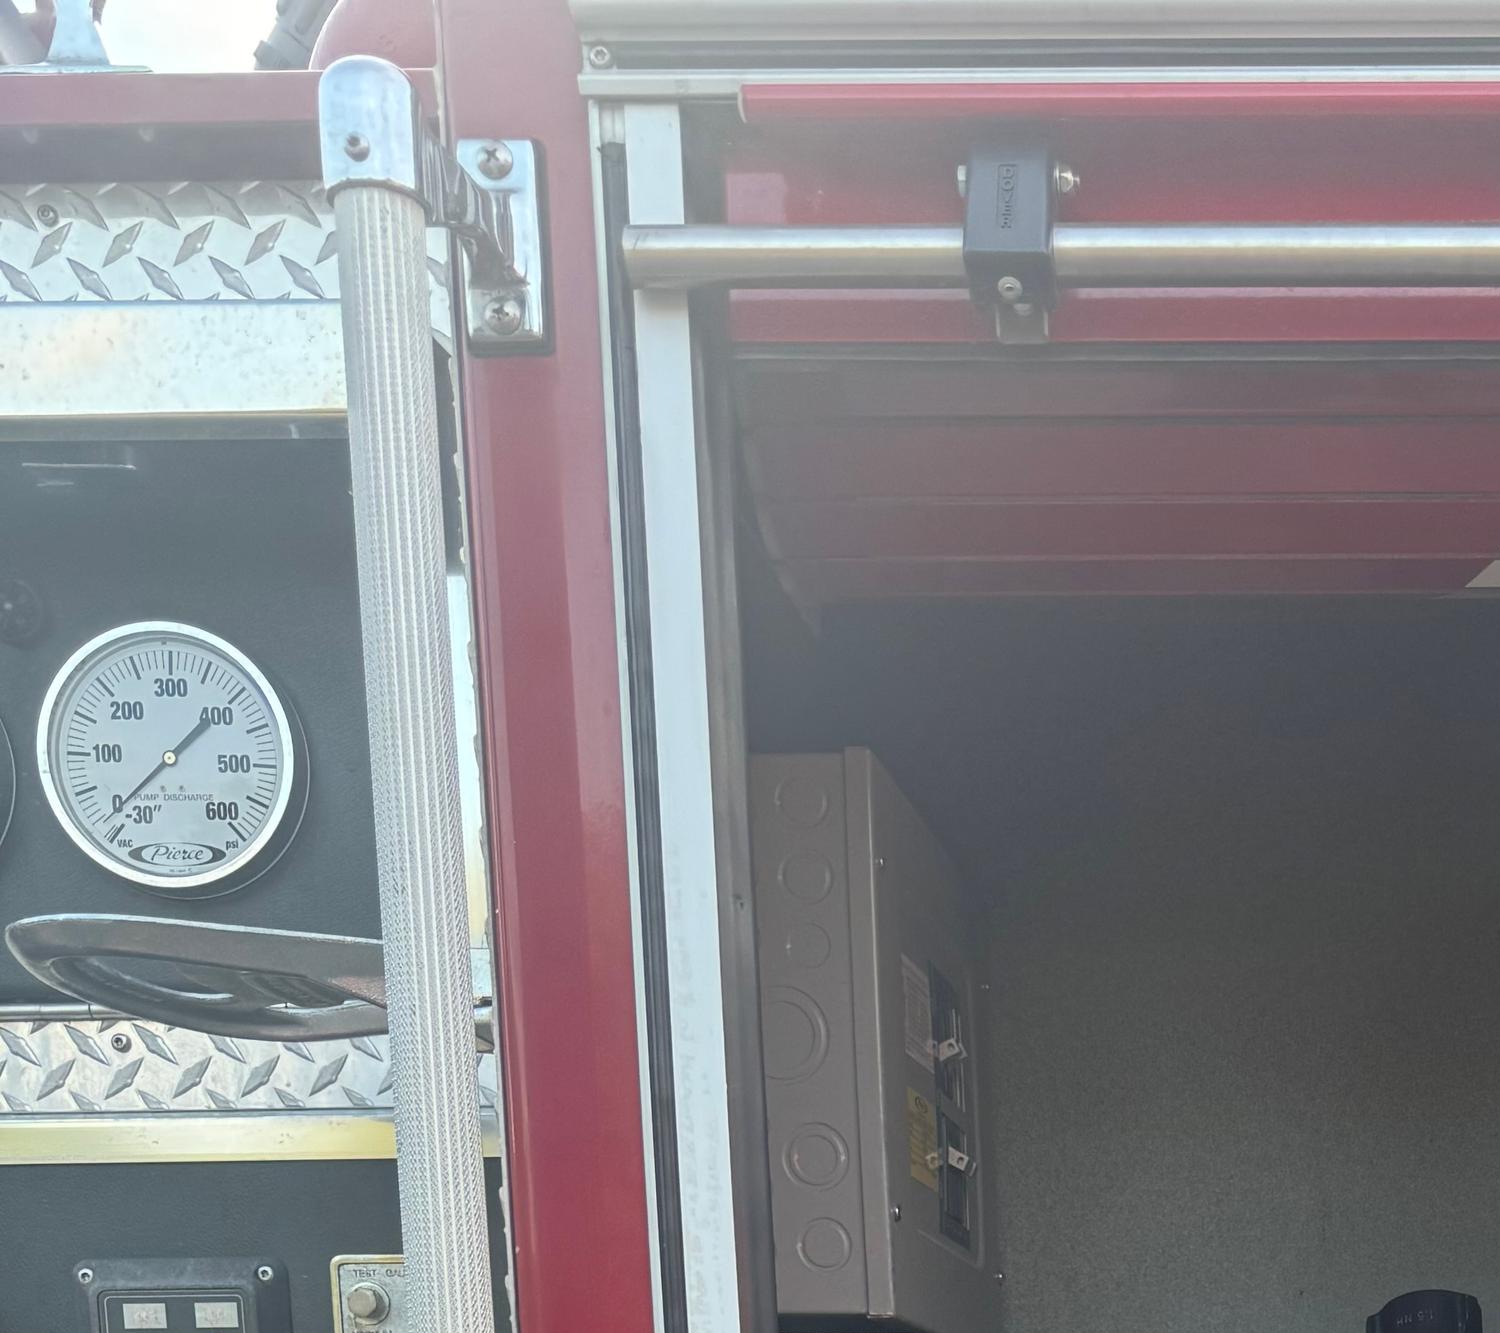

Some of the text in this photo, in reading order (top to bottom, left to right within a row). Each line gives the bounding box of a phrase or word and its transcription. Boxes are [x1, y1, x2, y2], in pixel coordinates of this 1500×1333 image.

[1000, 165, 1016, 229] DOVER
[154, 678, 188, 698] 300
[110, 701, 144, 720] 200
[200, 707, 233, 725] 400
[93, 744, 122, 763] 100
[217, 754, 251, 773] 500
[112, 794, 124, 813] 0
[206, 801, 239, 821] 600
[117, 839, 133, 848] VAC
[151, 845, 204, 861] Pierce
[225, 839, 239, 850] psi
[353, 1269, 377, 1278] TEST
